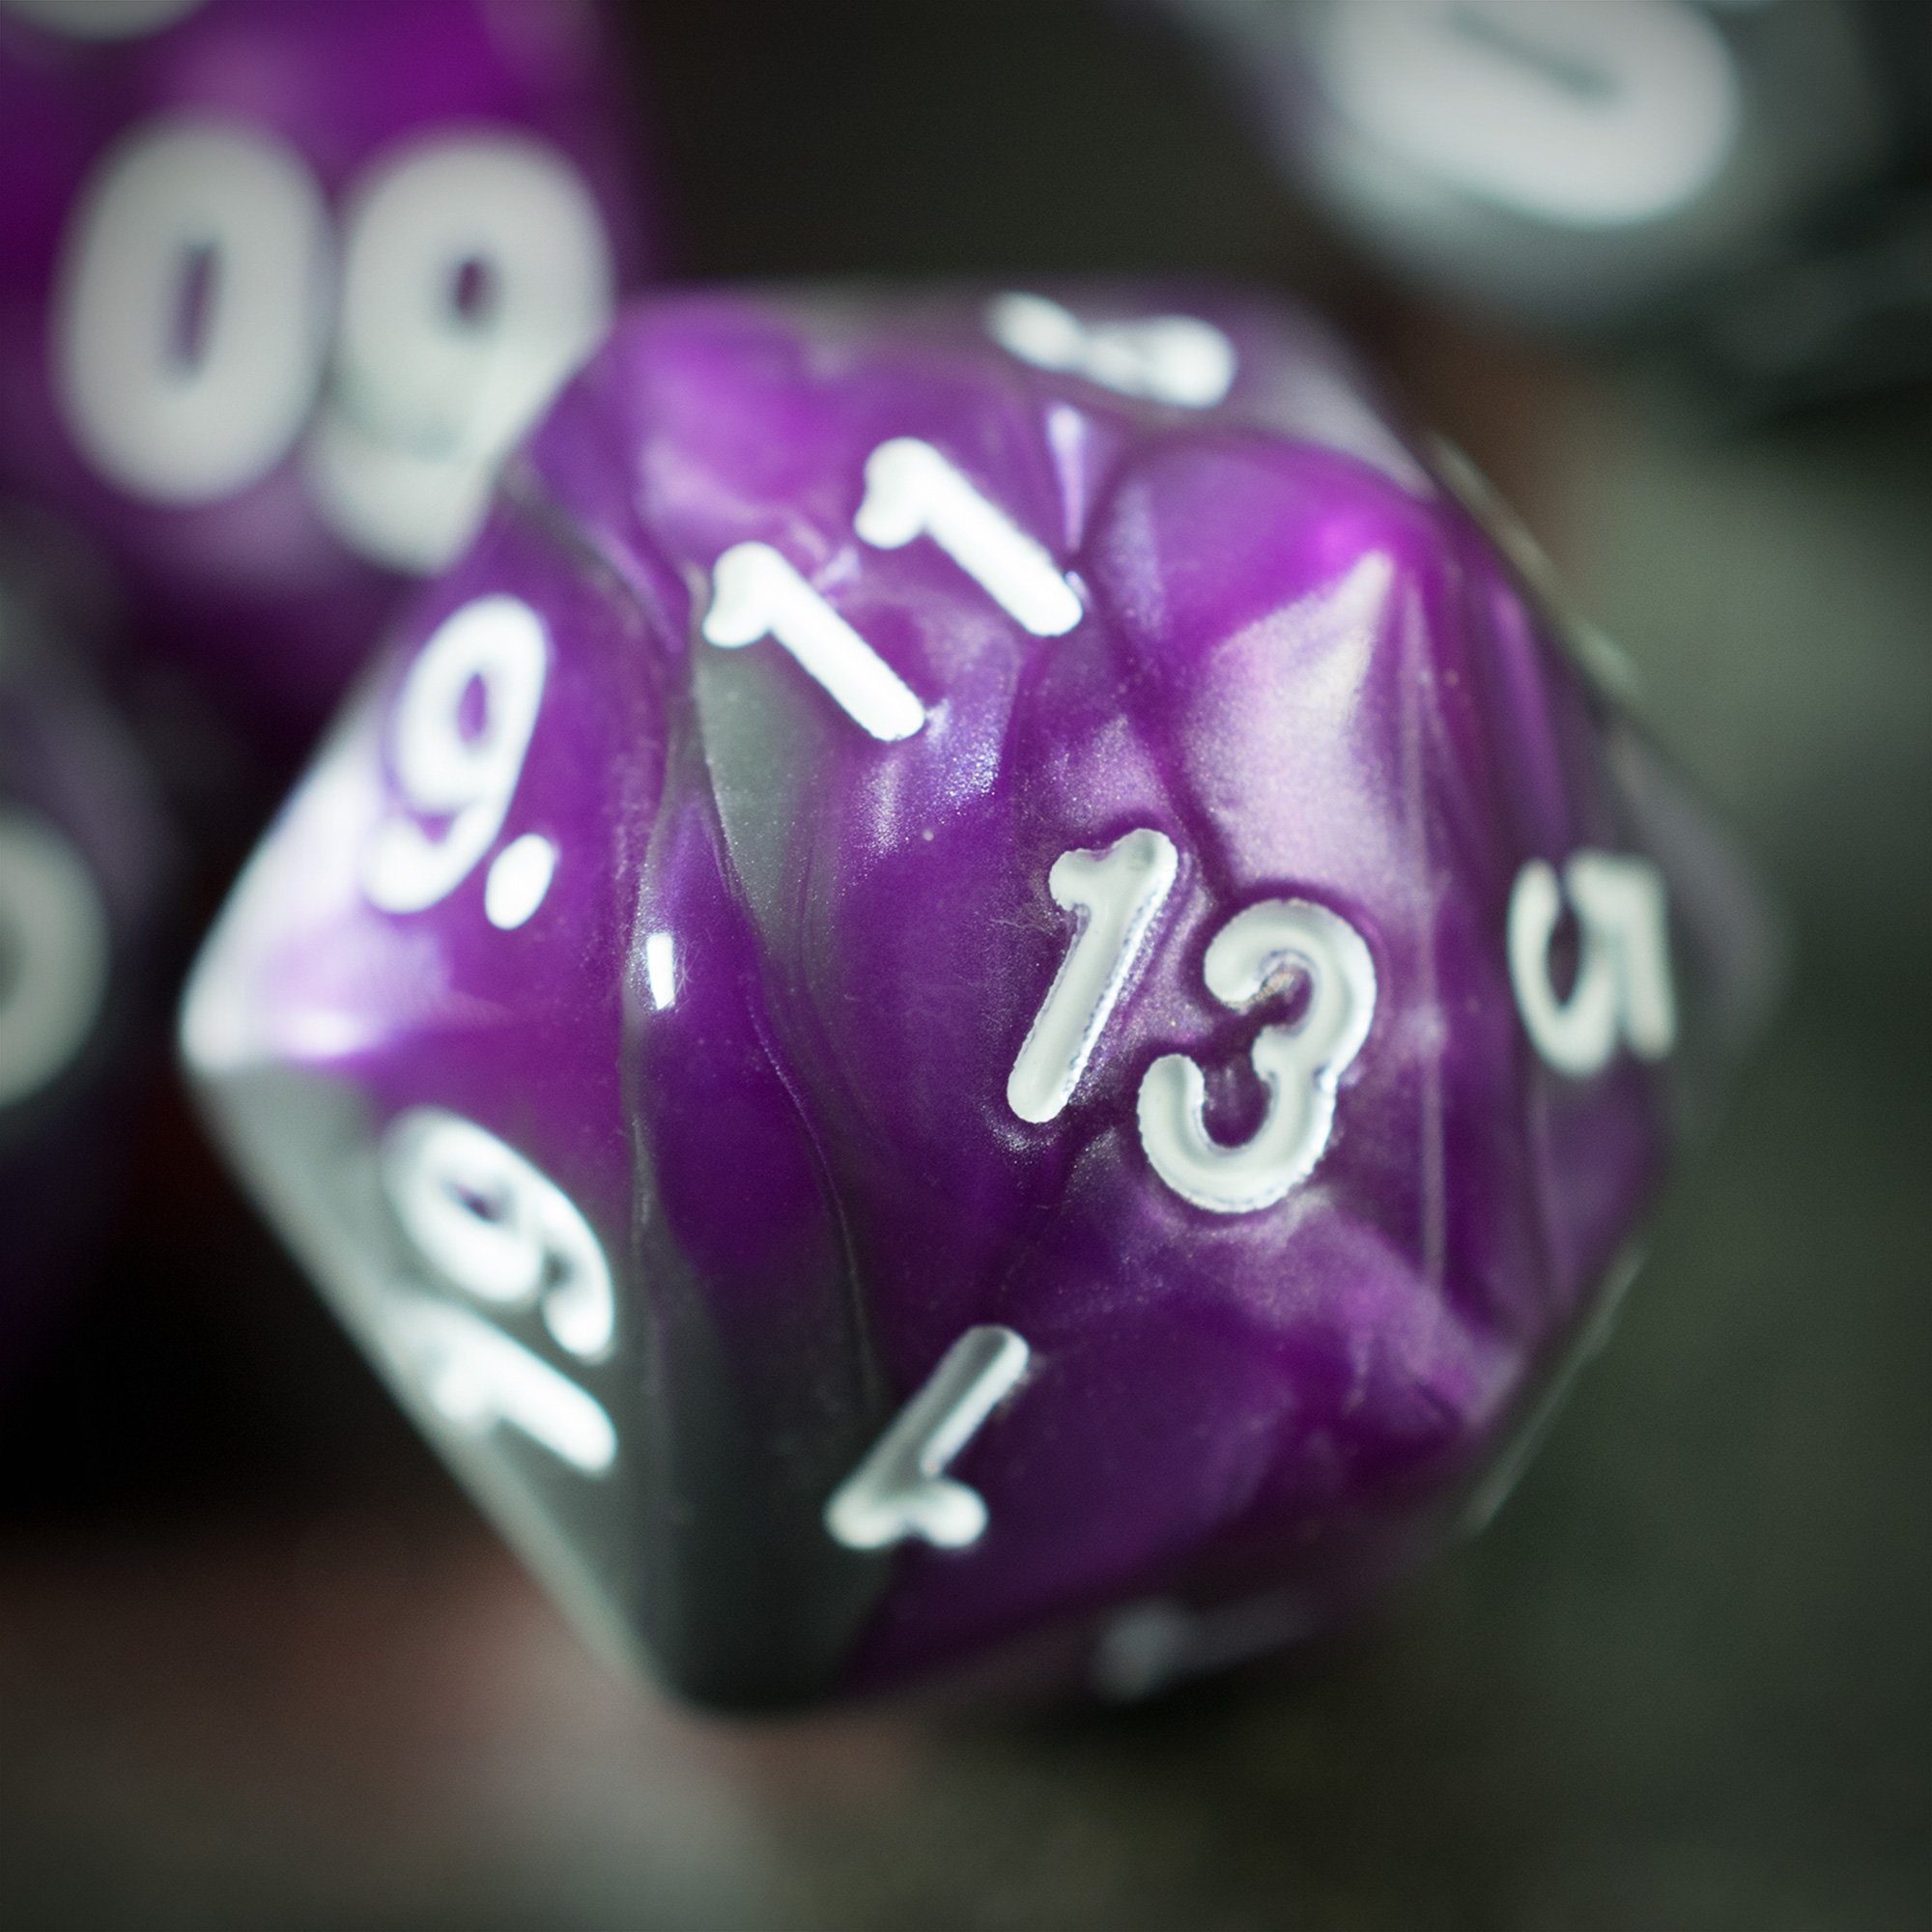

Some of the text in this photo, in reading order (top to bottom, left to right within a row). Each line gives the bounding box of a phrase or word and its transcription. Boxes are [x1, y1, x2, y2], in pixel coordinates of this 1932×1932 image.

[702, 436, 1084, 743] 11
[1007, 827, 1377, 1214] 13
[388, 1107, 617, 1475] 19
[825, 1324, 1030, 1548] 1
